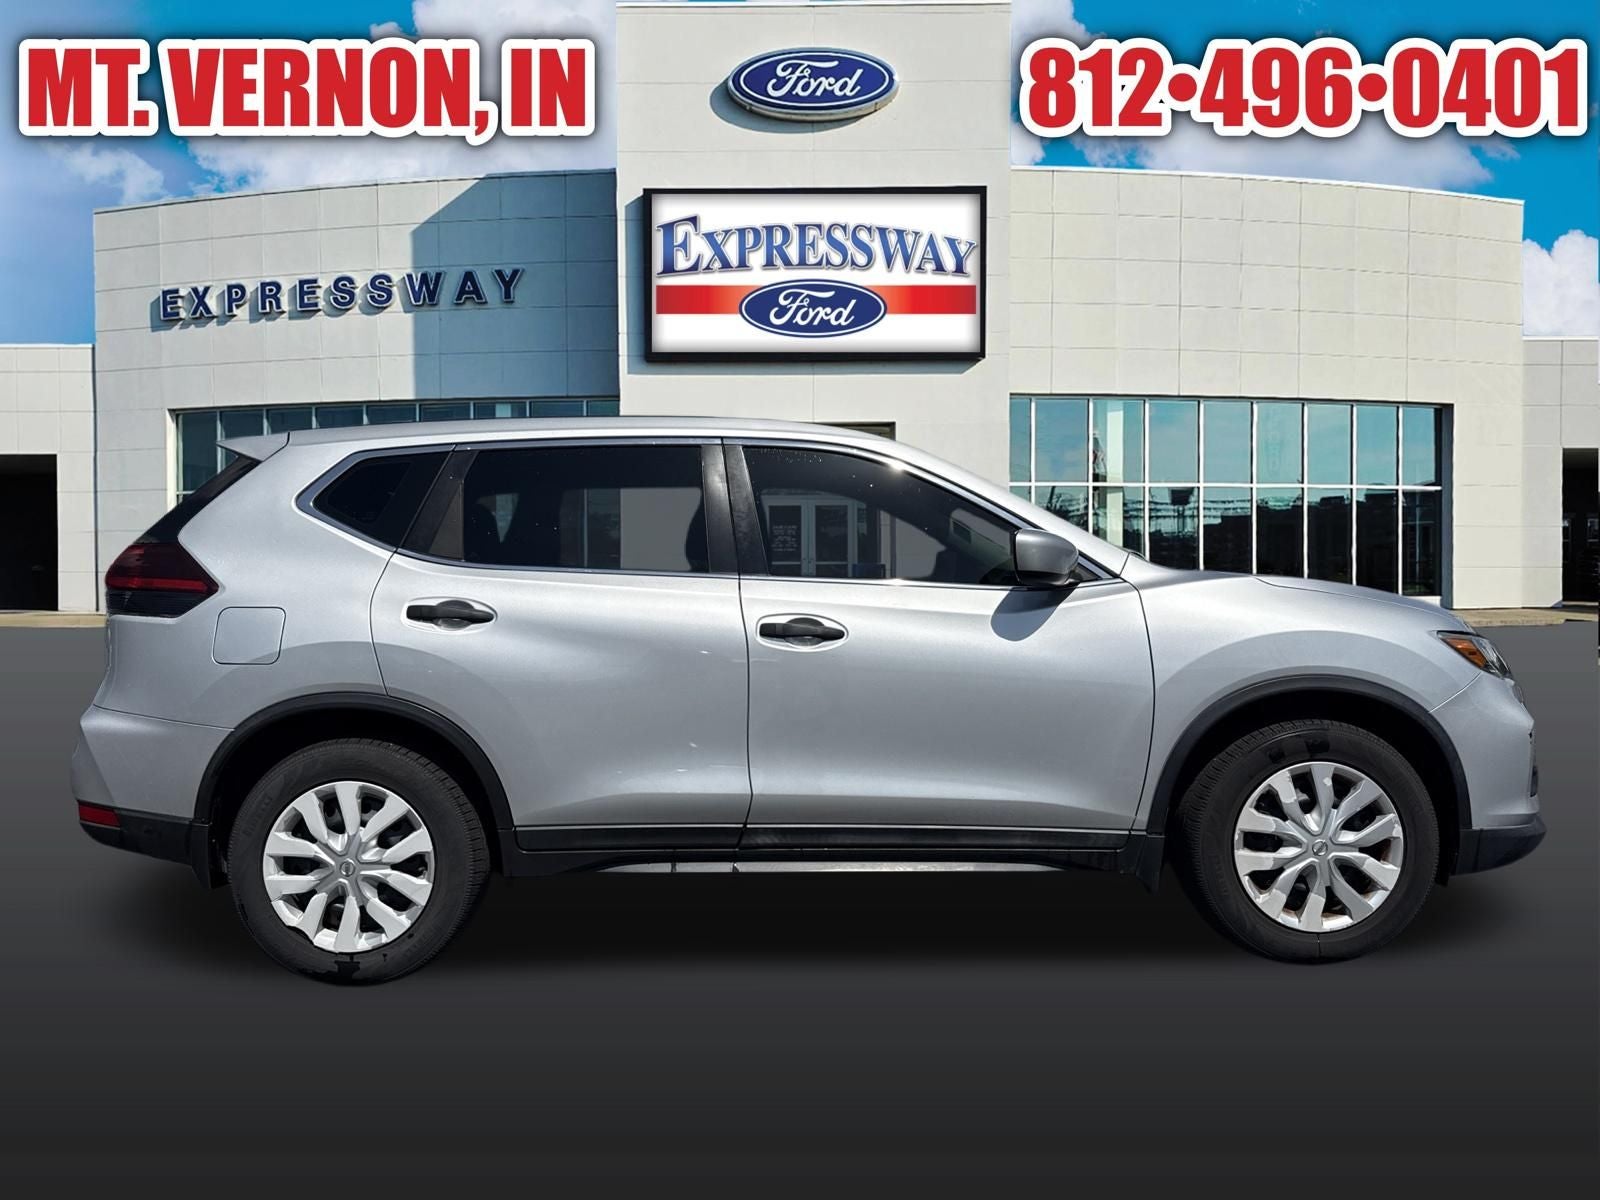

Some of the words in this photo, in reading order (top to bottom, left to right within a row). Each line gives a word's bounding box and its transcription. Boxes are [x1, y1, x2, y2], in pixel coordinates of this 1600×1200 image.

[766, 60, 863, 98] Ford
[160, 267, 526, 321] EXPRESSWAY
[769, 287, 856, 326] Ford
